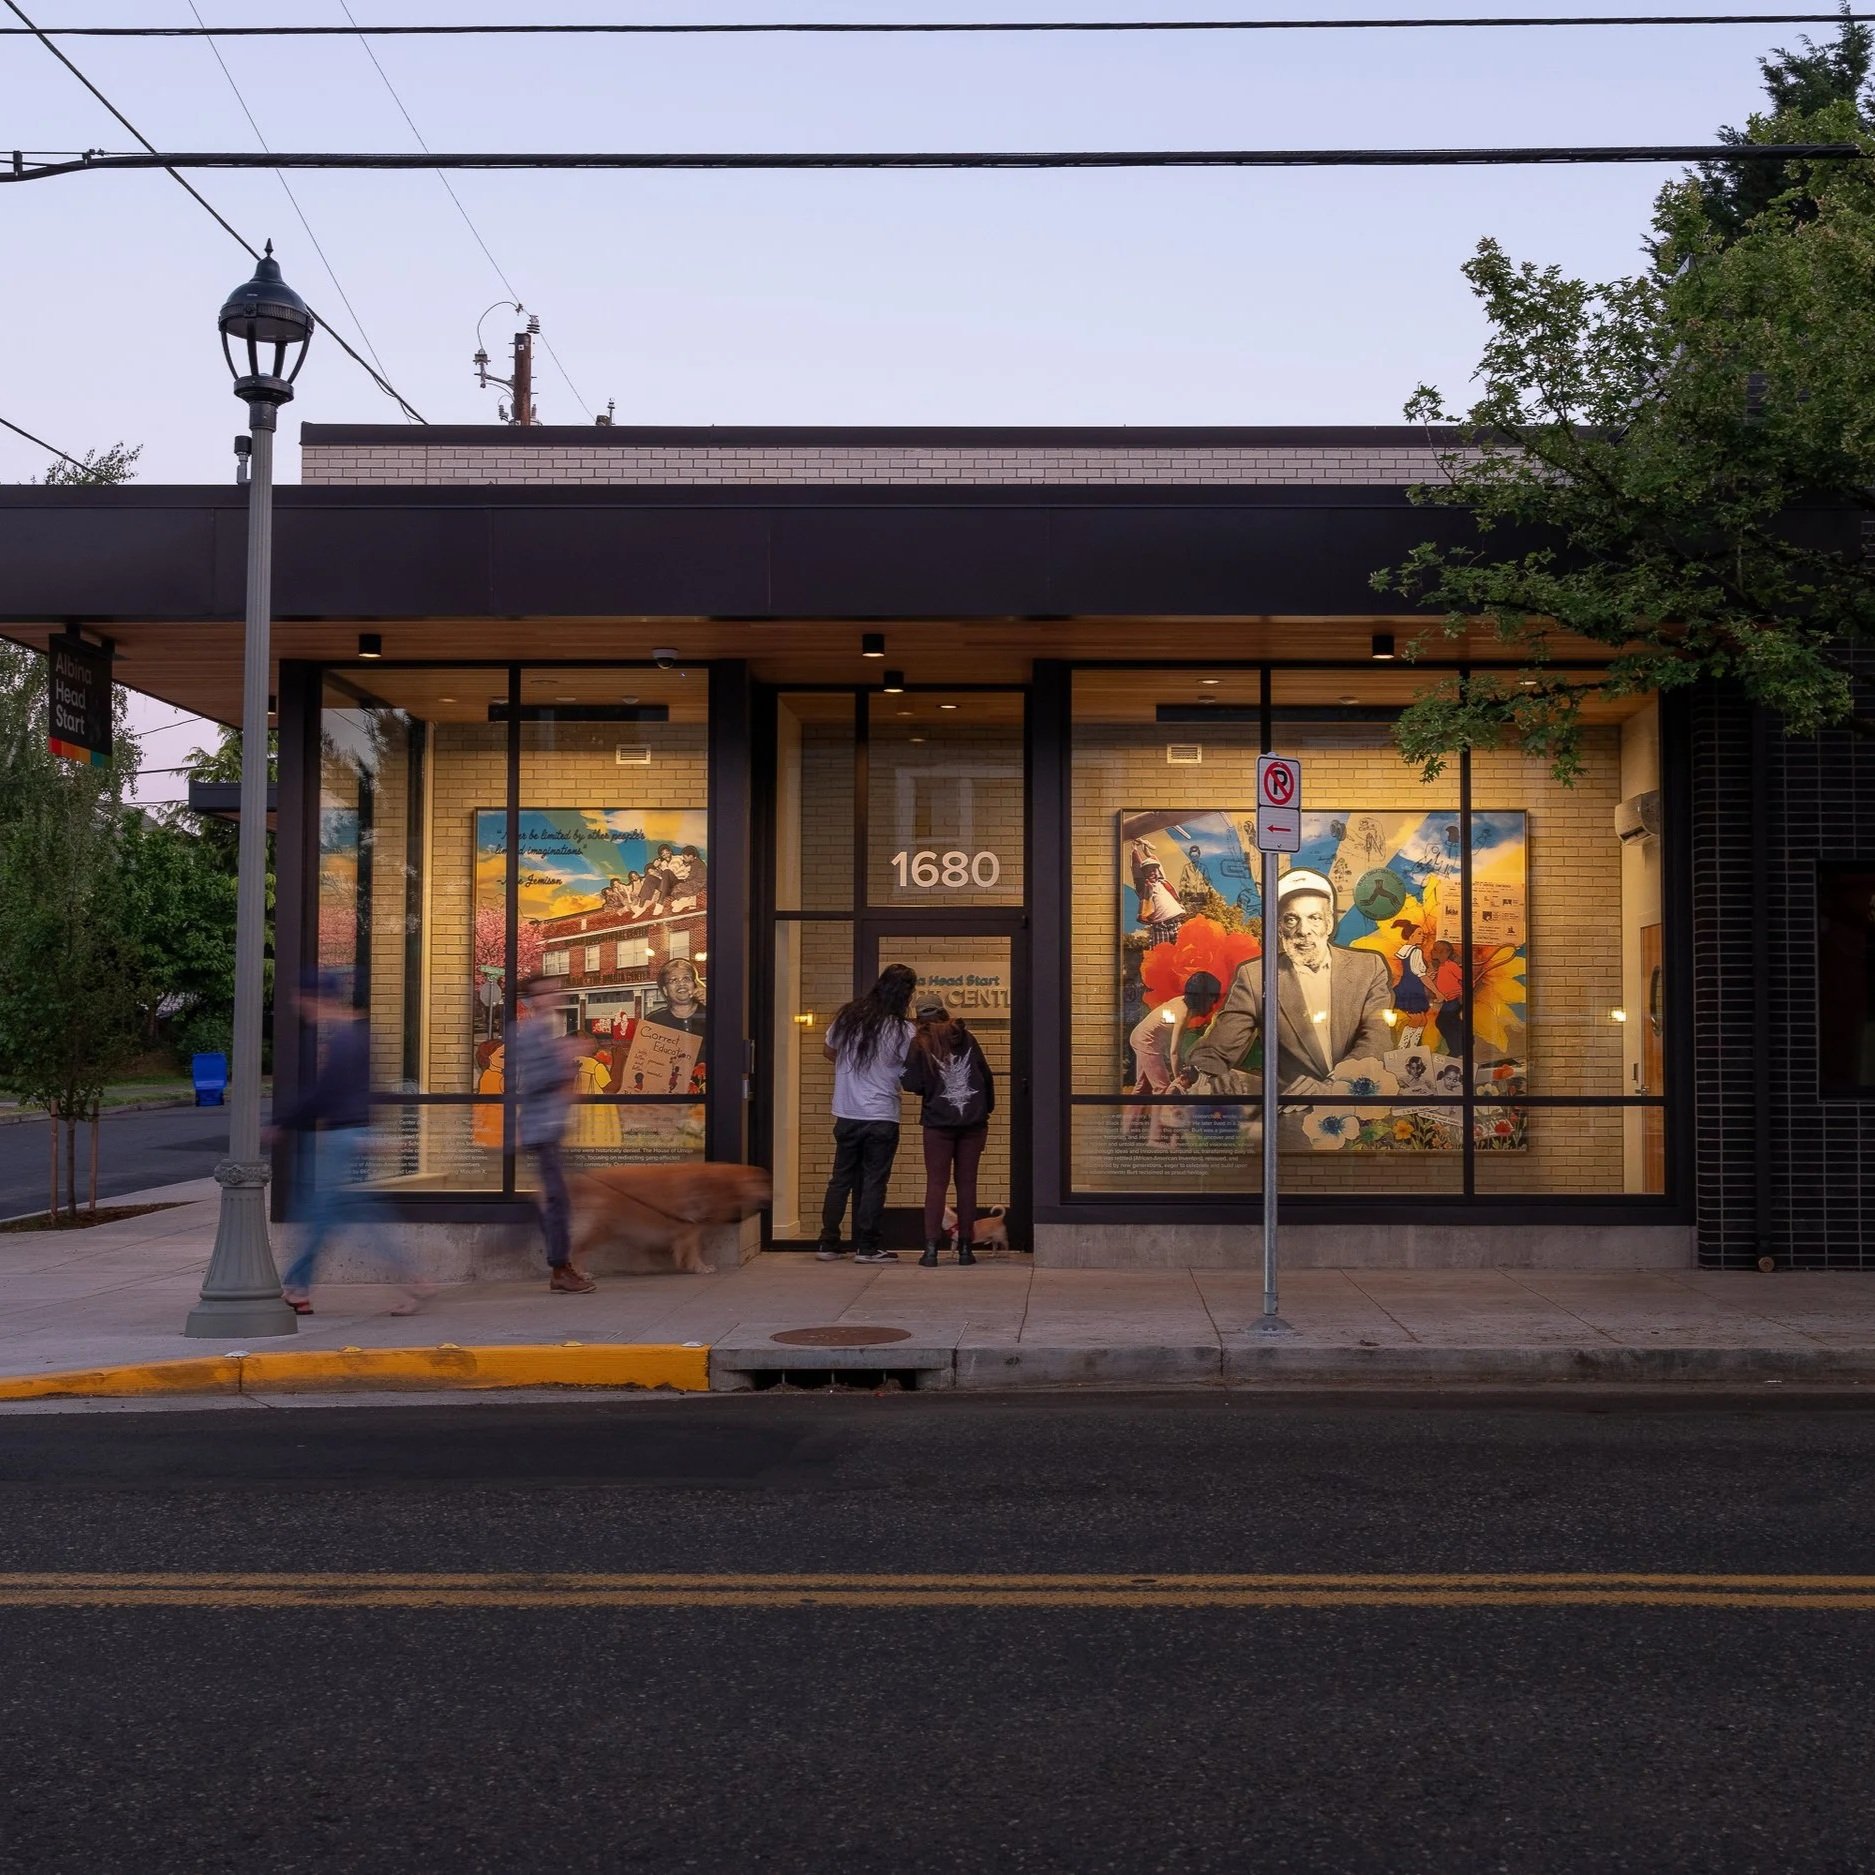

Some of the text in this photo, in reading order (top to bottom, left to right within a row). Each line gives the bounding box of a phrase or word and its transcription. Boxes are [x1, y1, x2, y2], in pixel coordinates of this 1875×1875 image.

[56, 652, 92, 684] Albina
[56, 678, 86, 710] Head
[56, 703, 85, 735] Start
[529, 829, 538, 840] be
[540, 829, 571, 840] limited
[573, 829, 585, 844] by
[587, 829, 609, 841] other
[891, 851, 1000, 887] 1680
[525, 874, 563, 888] Jemison
[928, 974, 963, 986] Head
[966, 974, 1001, 986] Start
[948, 986, 1010, 1006] CENT
[640, 1026, 680, 1046] Correct
